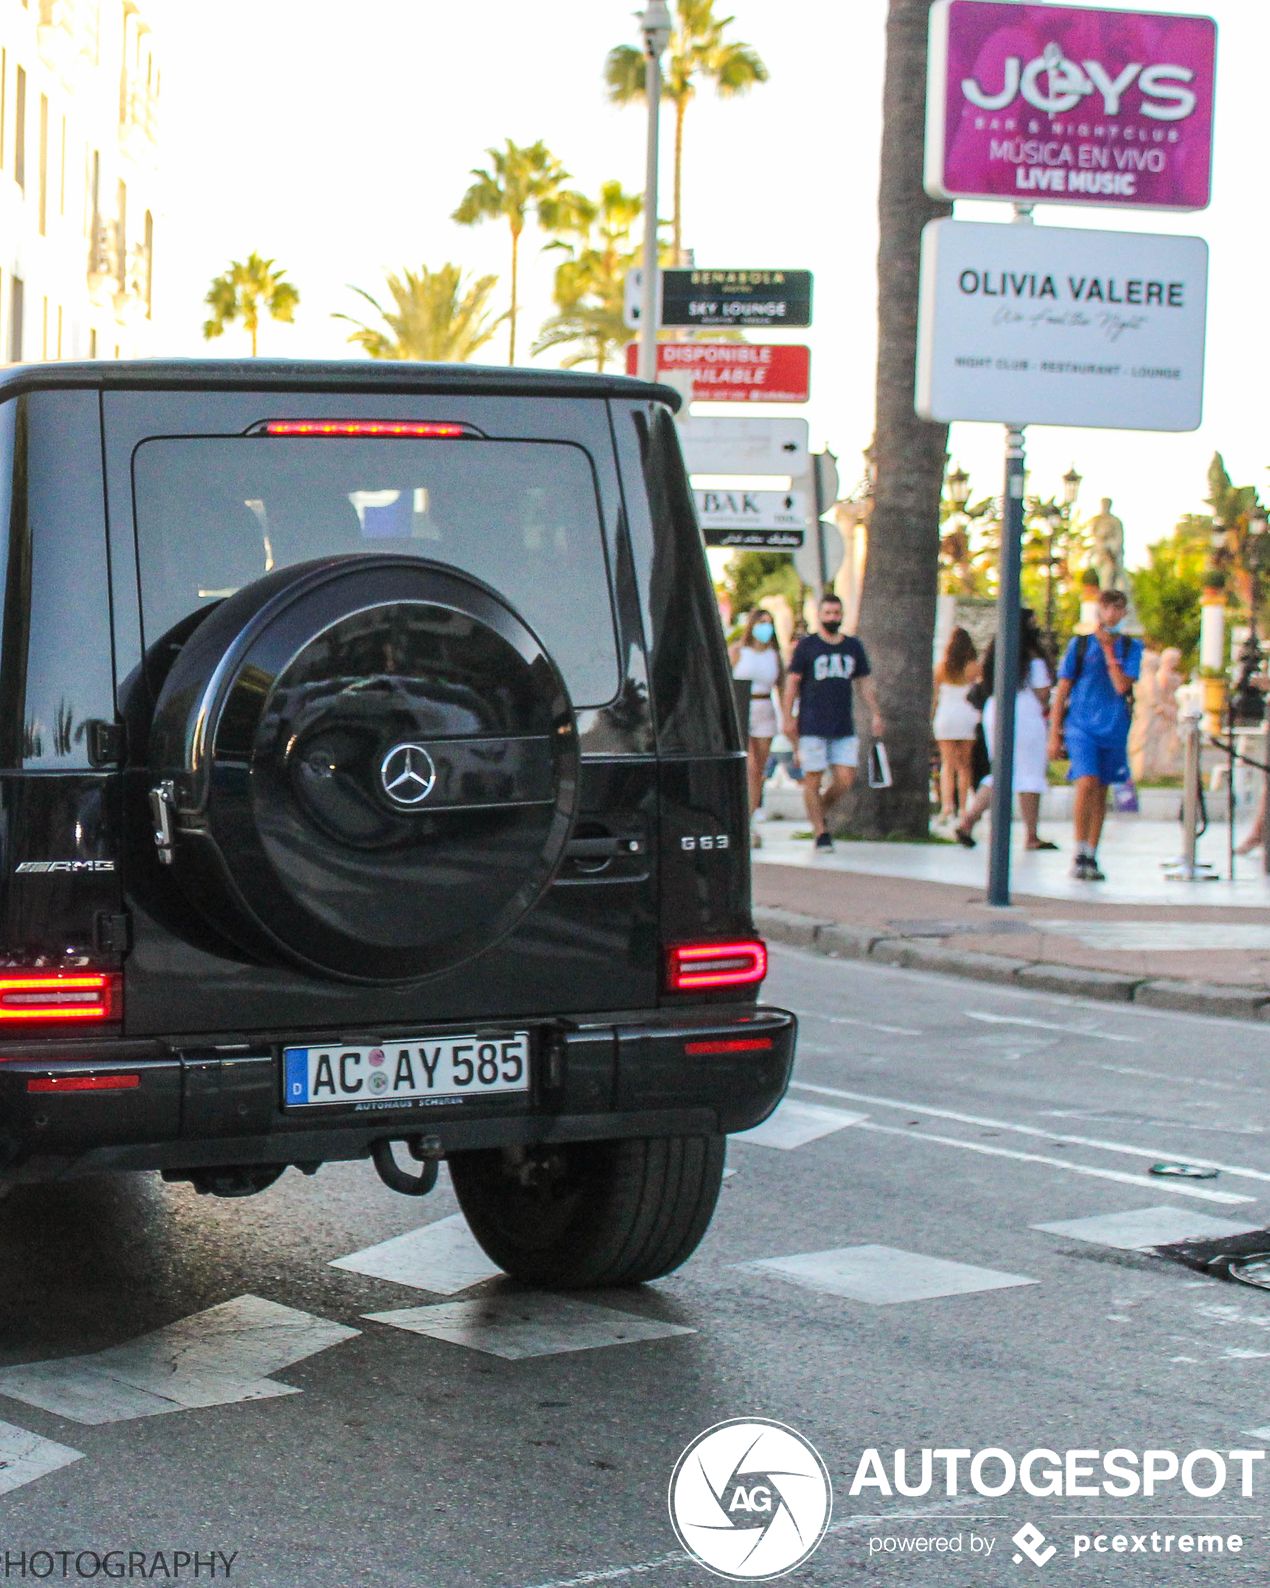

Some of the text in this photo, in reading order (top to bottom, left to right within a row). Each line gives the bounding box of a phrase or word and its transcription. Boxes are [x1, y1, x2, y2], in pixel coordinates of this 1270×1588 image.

[961, 54, 1197, 121] JOYS
[1079, 143, 1109, 169] EN
[1110, 147, 1165, 173] VIVO
[1016, 167, 1137, 196] LIVE MUSIC
[958, 269, 1184, 308] OLIVIA VALERE
[688, 301, 786, 317] SKY LOUNGE
[663, 346, 772, 363] DISPONIBLE
[691, 367, 767, 384] AILABLE
[955, 356, 1181, 380] NIGHT CLUB RESTAURANT LOUNGE
[814, 653, 856, 681] GAP
[48, 860, 115, 873] AMG
[292, 1042, 523, 1096] D AC AY 585
[354, 1100, 413, 1111] AUTOHAUS
